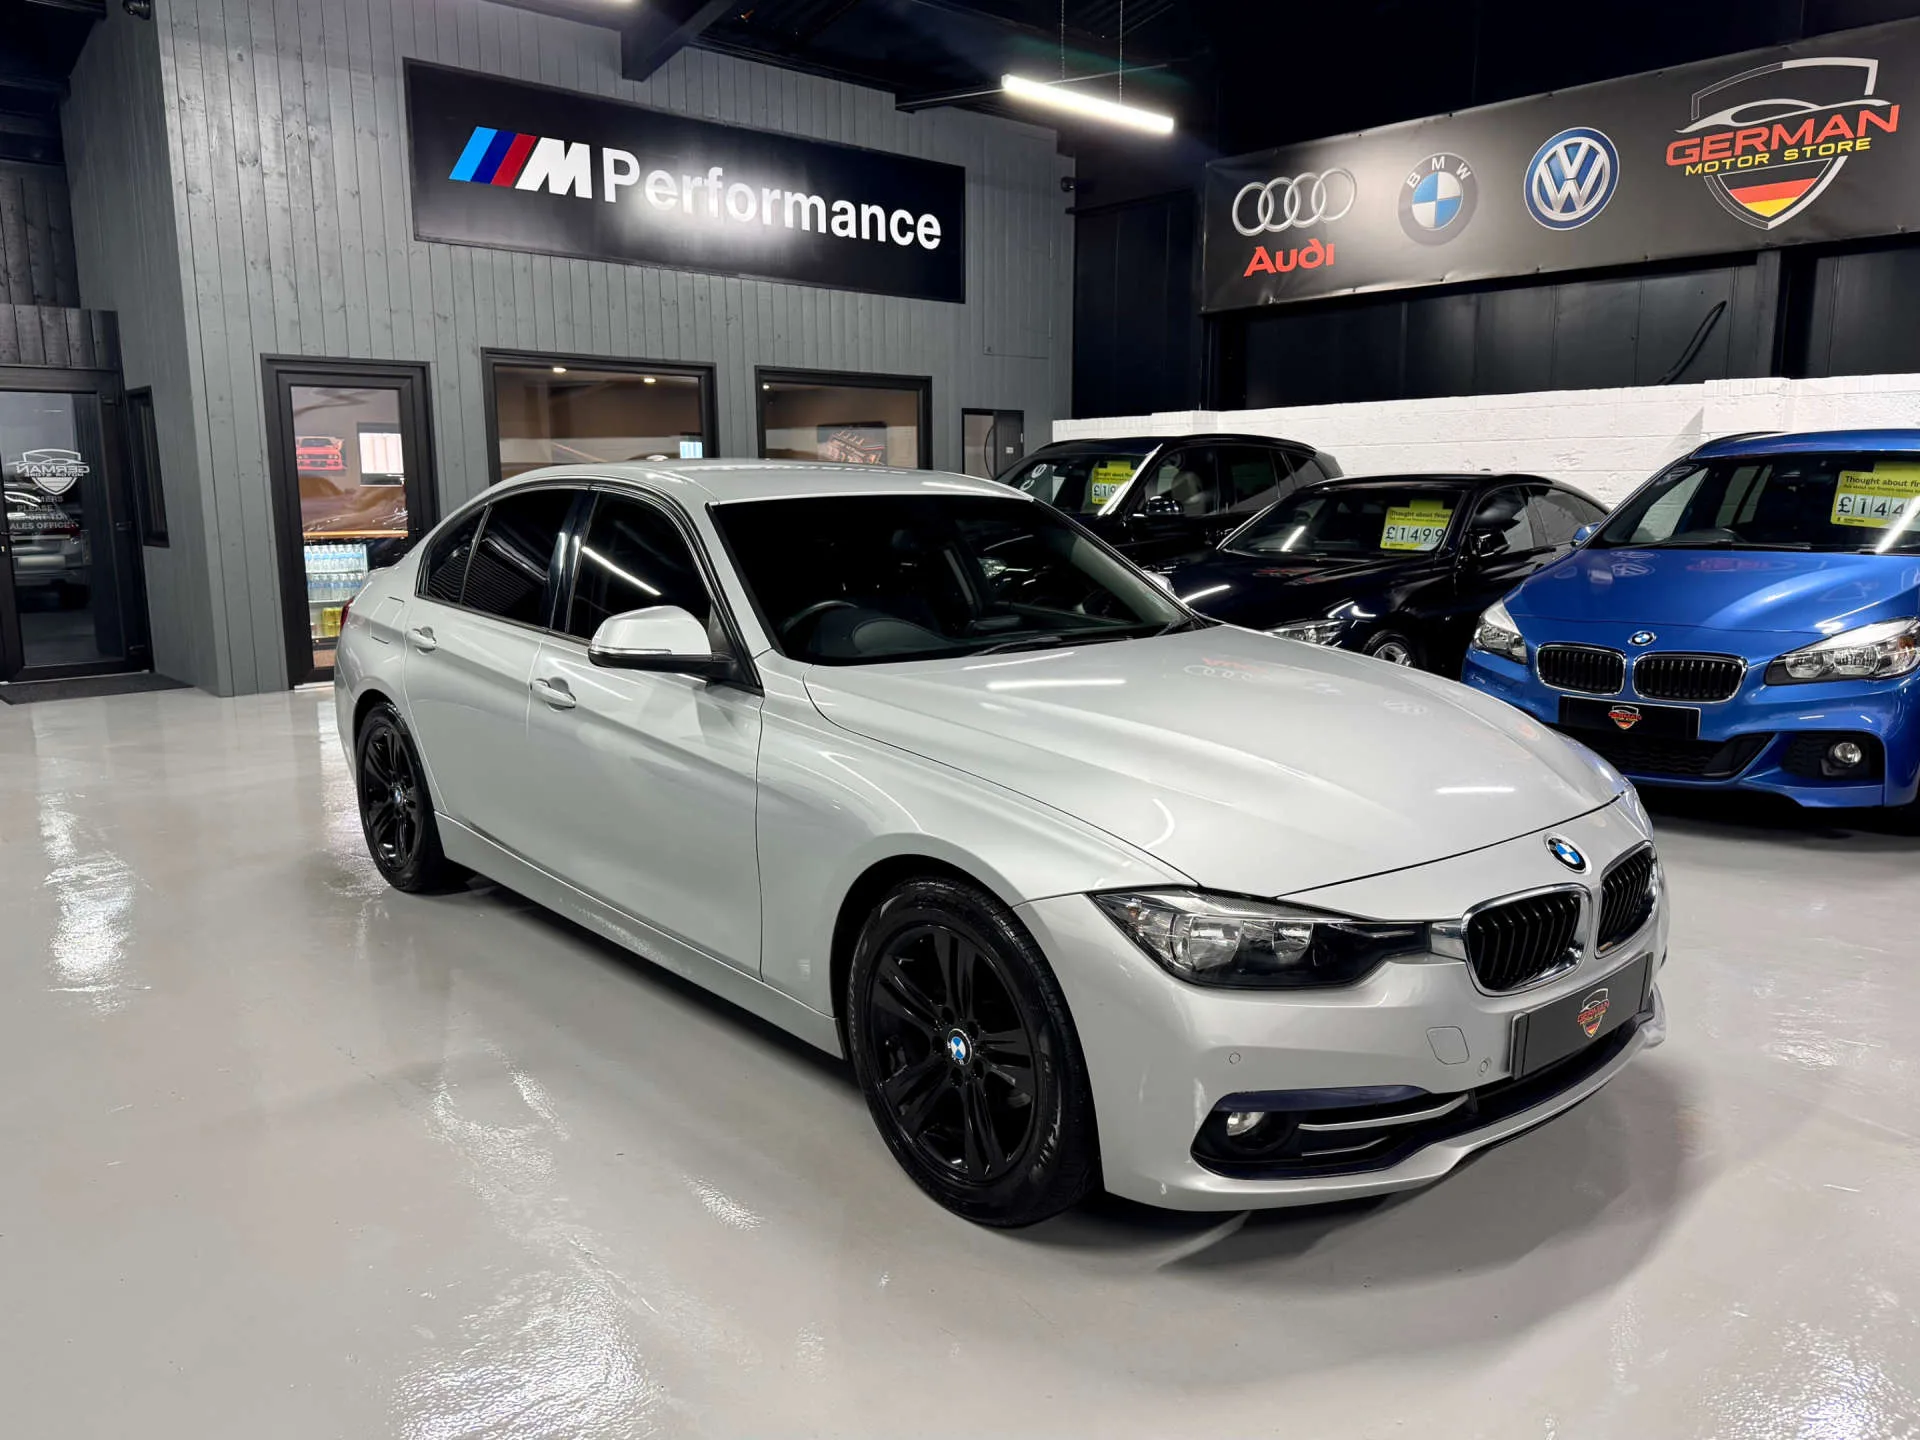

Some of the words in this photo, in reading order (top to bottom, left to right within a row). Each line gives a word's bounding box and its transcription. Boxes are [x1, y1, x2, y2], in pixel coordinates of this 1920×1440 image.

[1665, 104, 1900, 166] GERMAN
[1406, 155, 1471, 189] BMW
[1685, 152, 1769, 176] MOTOR
[1783, 137, 1872, 161] STORE
[514, 136, 593, 199] M
[602, 146, 942, 250] Performance
[1243, 238, 1335, 277] Audi
[1845, 476, 1880, 485] Thought
[1882, 479, 1907, 487] about
[1385, 526, 1444, 542] £1499
